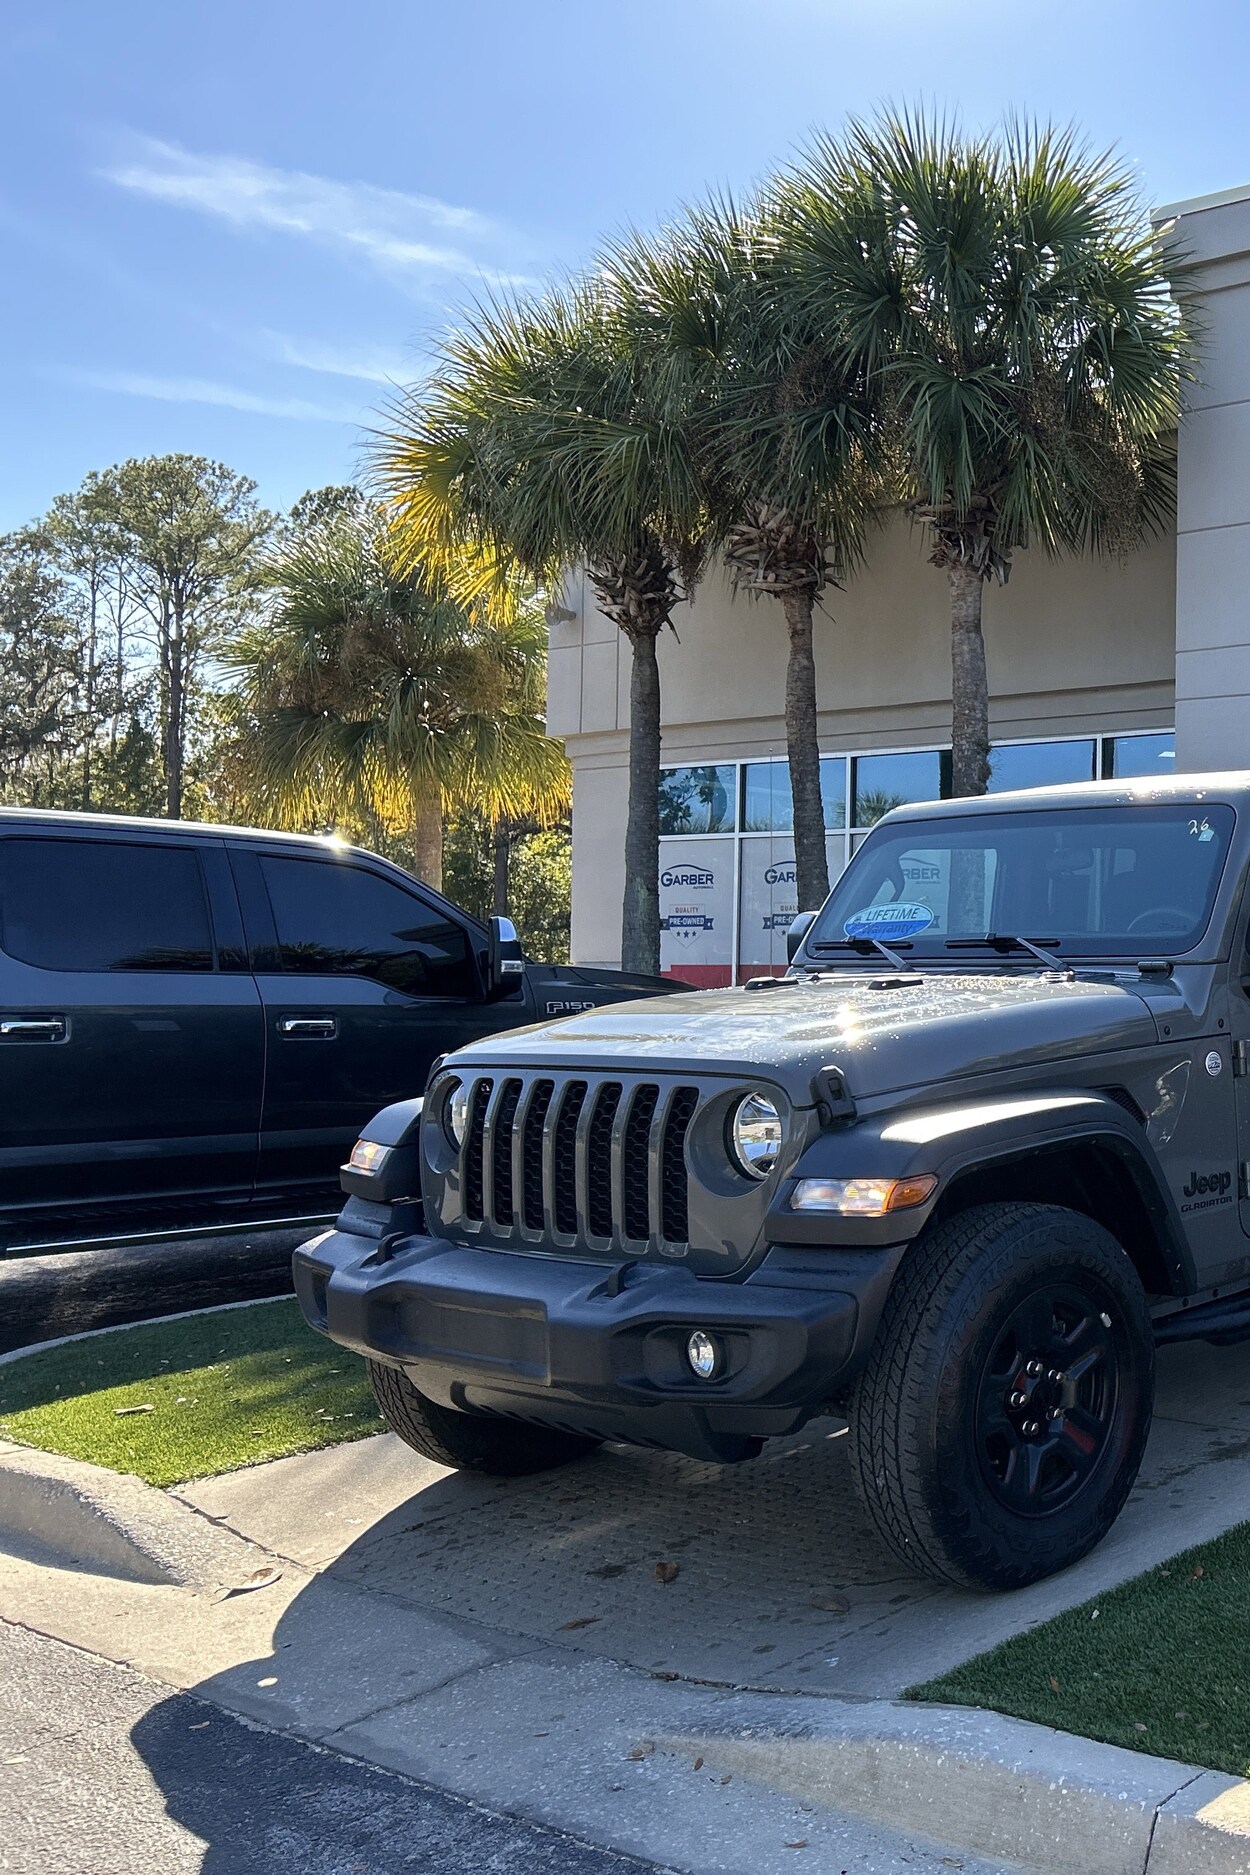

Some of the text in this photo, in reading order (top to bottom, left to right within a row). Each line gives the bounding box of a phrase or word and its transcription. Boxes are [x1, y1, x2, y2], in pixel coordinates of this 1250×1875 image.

[661, 871, 714, 887] GARBER
[764, 868, 797, 885] GAR
[901, 868, 940, 880] RBER
[675, 906, 699, 914] QUALITY
[866, 907, 921, 921] LIFETIME
[669, 915, 705, 926] PRE-OWNED
[774, 915, 795, 925] PRE-O
[1183, 1170, 1232, 1198] Jeep
[1181, 1195, 1232, 1213] GLADIATOR
